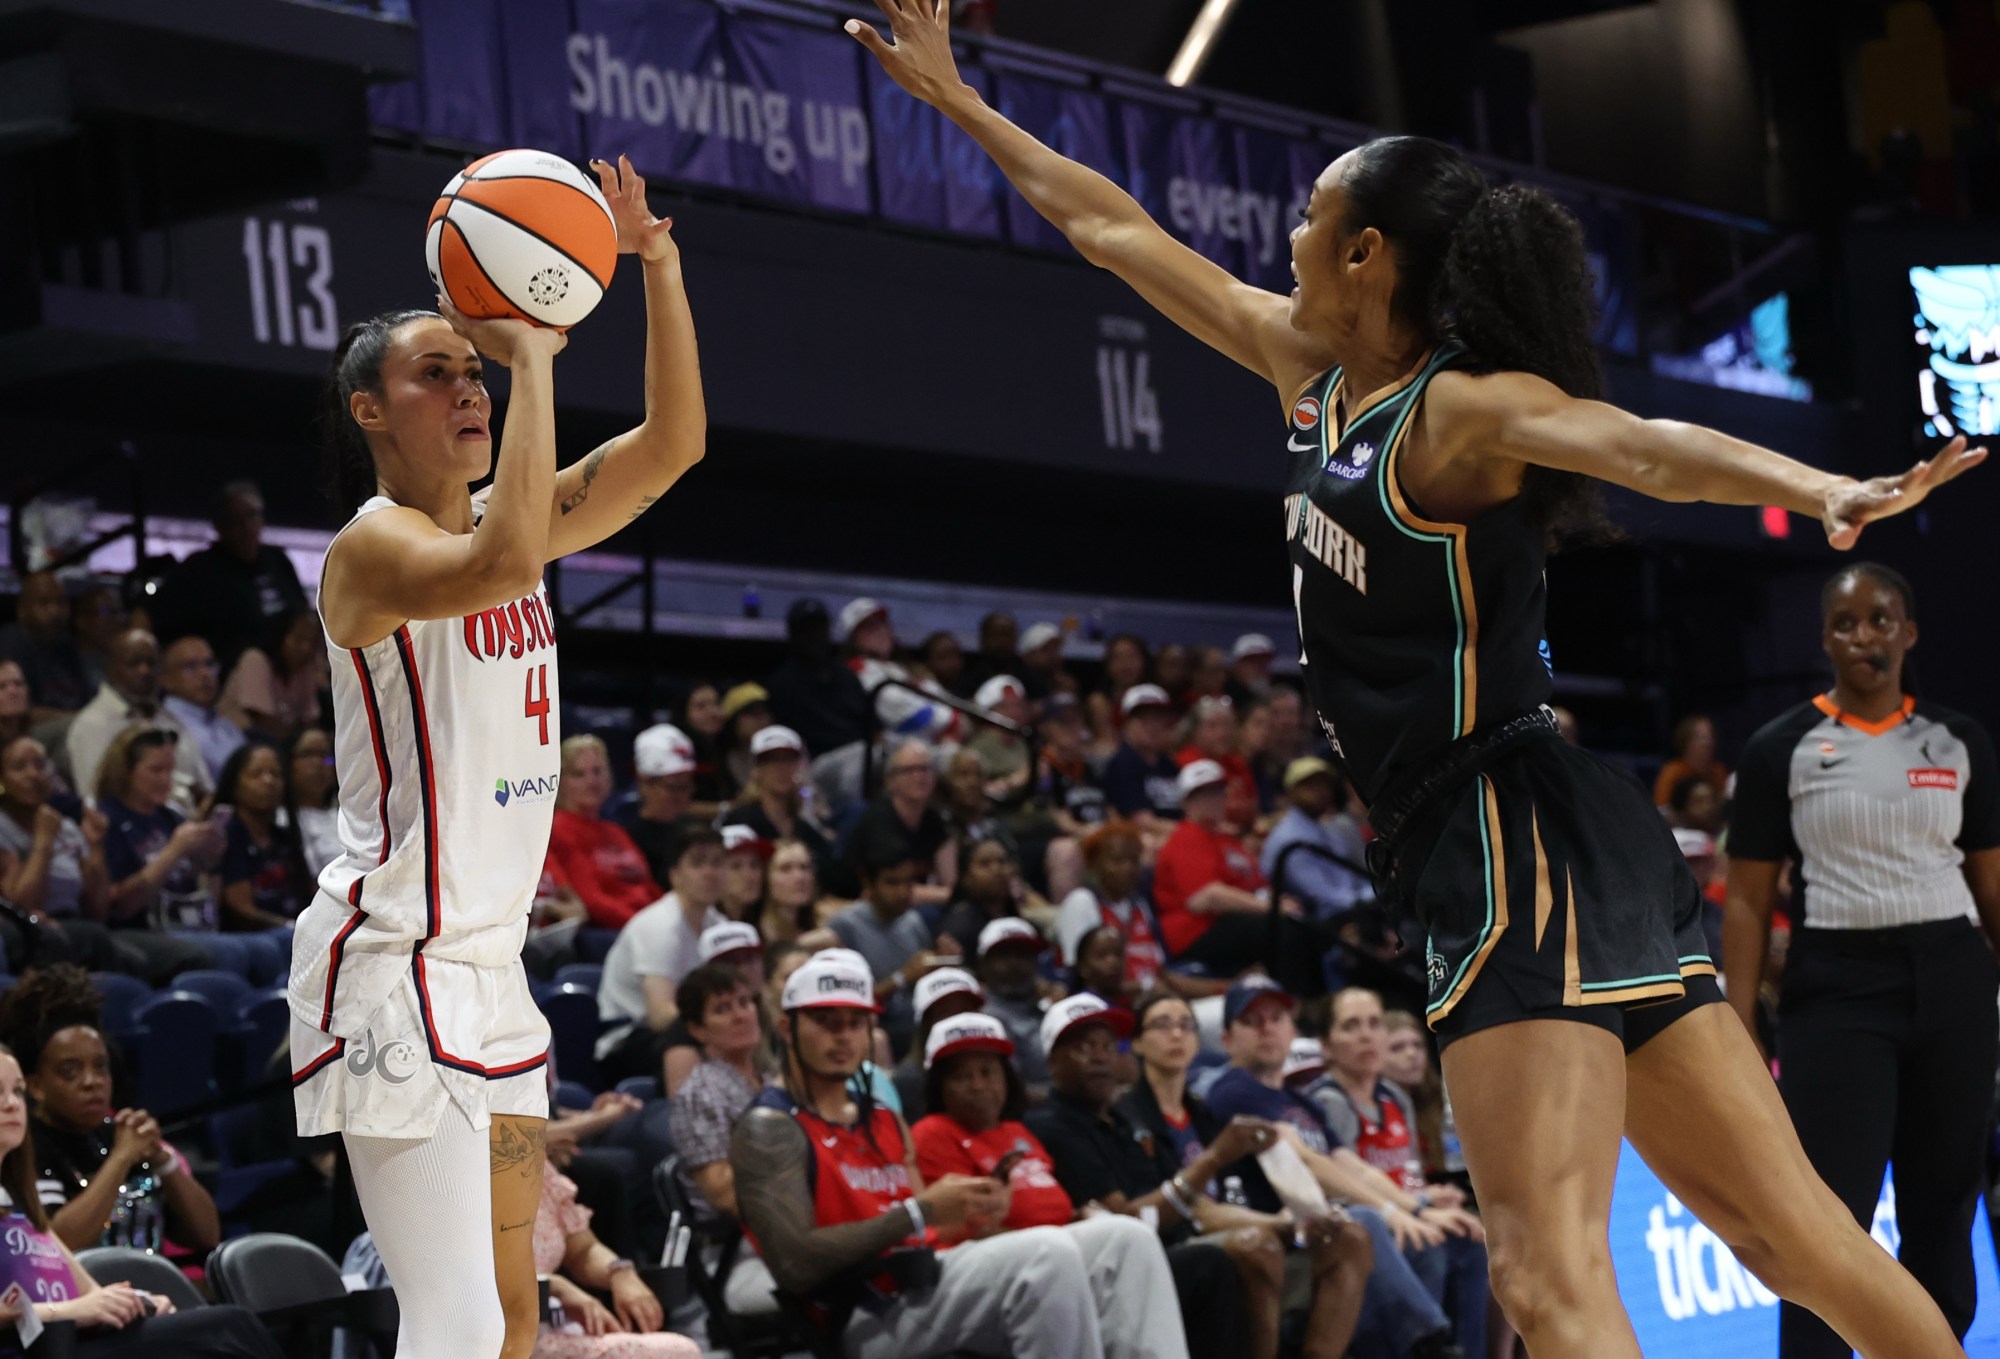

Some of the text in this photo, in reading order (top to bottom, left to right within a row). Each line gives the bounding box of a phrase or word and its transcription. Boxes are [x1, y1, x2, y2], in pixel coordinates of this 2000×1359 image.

[567, 34, 796, 174] Showing
[803, 101, 871, 186] up
[1167, 176, 1276, 266] every
[243, 216, 340, 350] 113
[1097, 347, 1162, 452] 114
[525, 664, 550, 745] 4
